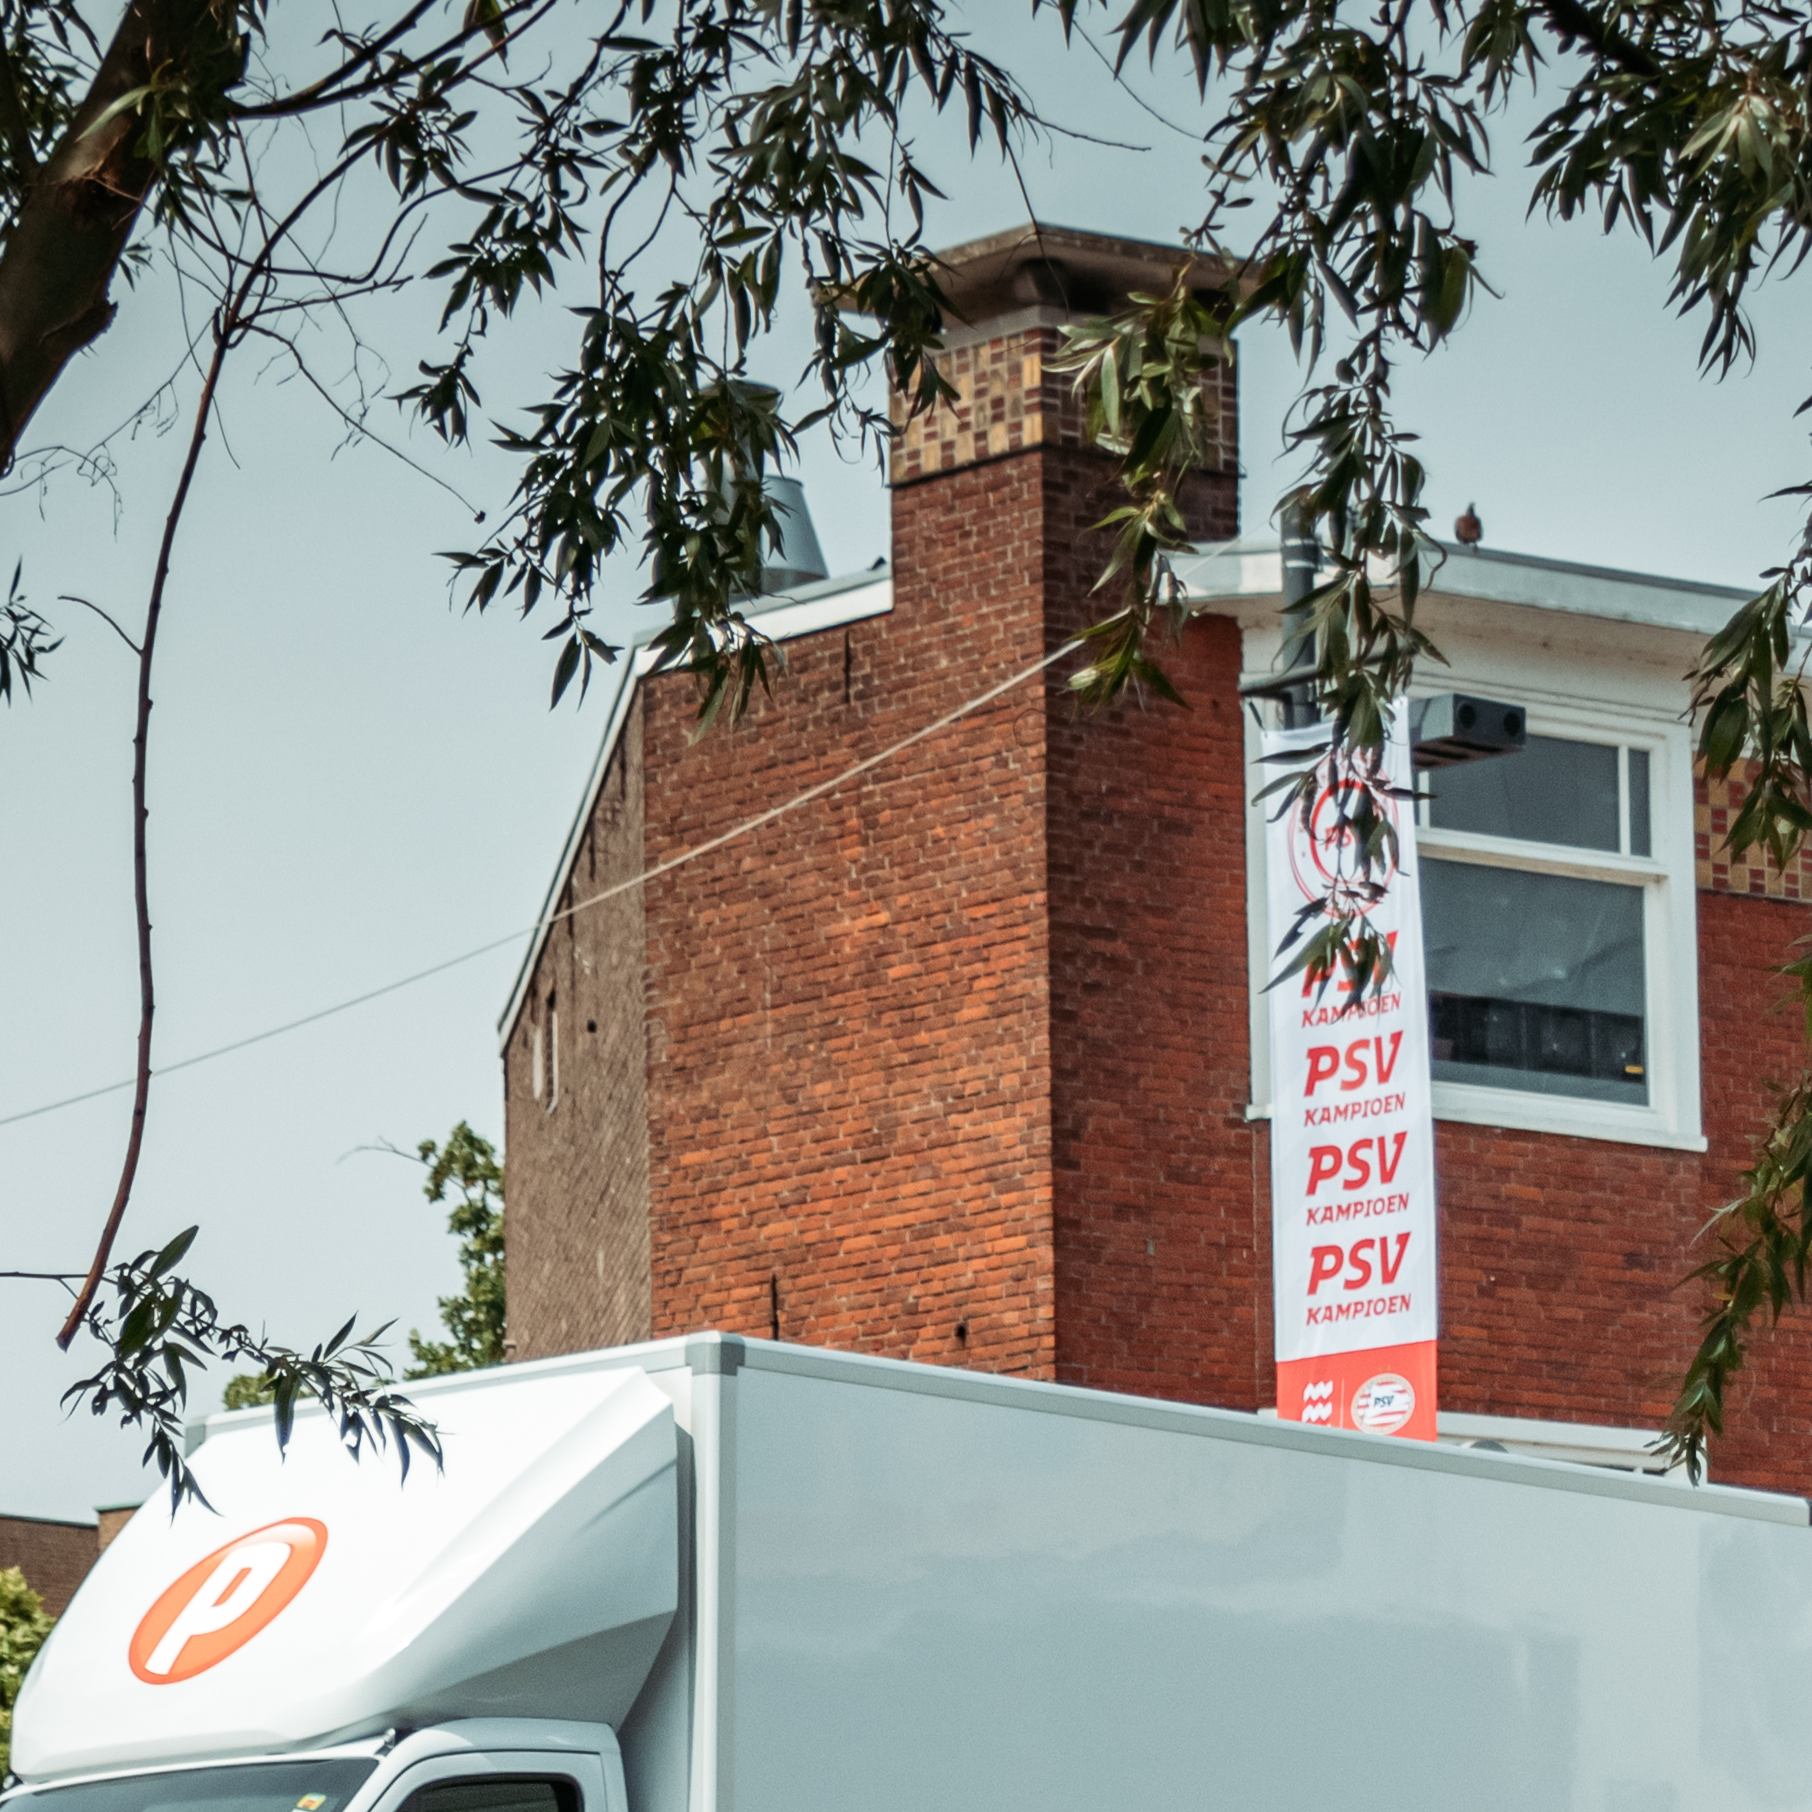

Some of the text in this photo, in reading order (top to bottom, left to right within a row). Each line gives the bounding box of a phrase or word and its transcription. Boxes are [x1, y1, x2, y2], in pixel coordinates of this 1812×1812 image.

[1304, 1030, 1404, 1097] PSV
[1304, 1092, 1406, 1127] KAMPIOEN
[1306, 1131, 1408, 1196] PSV
[1306, 1193, 1409, 1226] KAMPIOEN
[1307, 1231, 1411, 1296] PSV
[1306, 1293, 1412, 1326] KAMPIOEN
[1373, 1395, 1395, 1408] PSV
[144, 1541, 292, 1676] P
